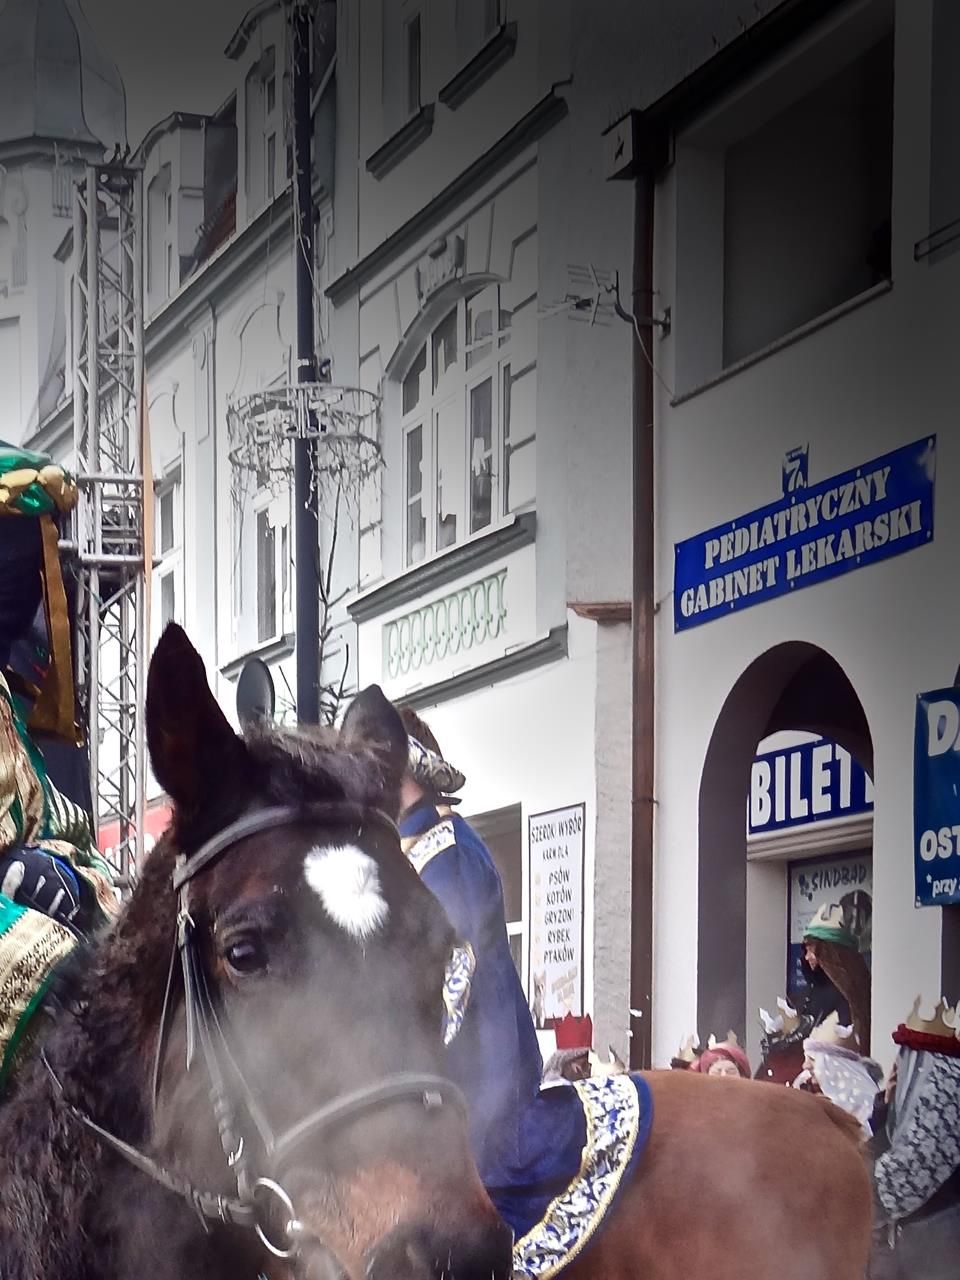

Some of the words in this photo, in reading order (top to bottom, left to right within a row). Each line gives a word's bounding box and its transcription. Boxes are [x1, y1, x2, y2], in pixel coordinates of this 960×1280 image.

[704, 466, 891, 570] PEDIATRYCZNY
[680, 555, 780, 618] GABINET
[786, 500, 923, 580] LEKARSKI
[548, 865, 570, 886] PSÓW
[811, 863, 867, 892] SINDBAD
[546, 885, 573, 905] KOTÓW
[543, 942, 575, 964] PTAKÓW
